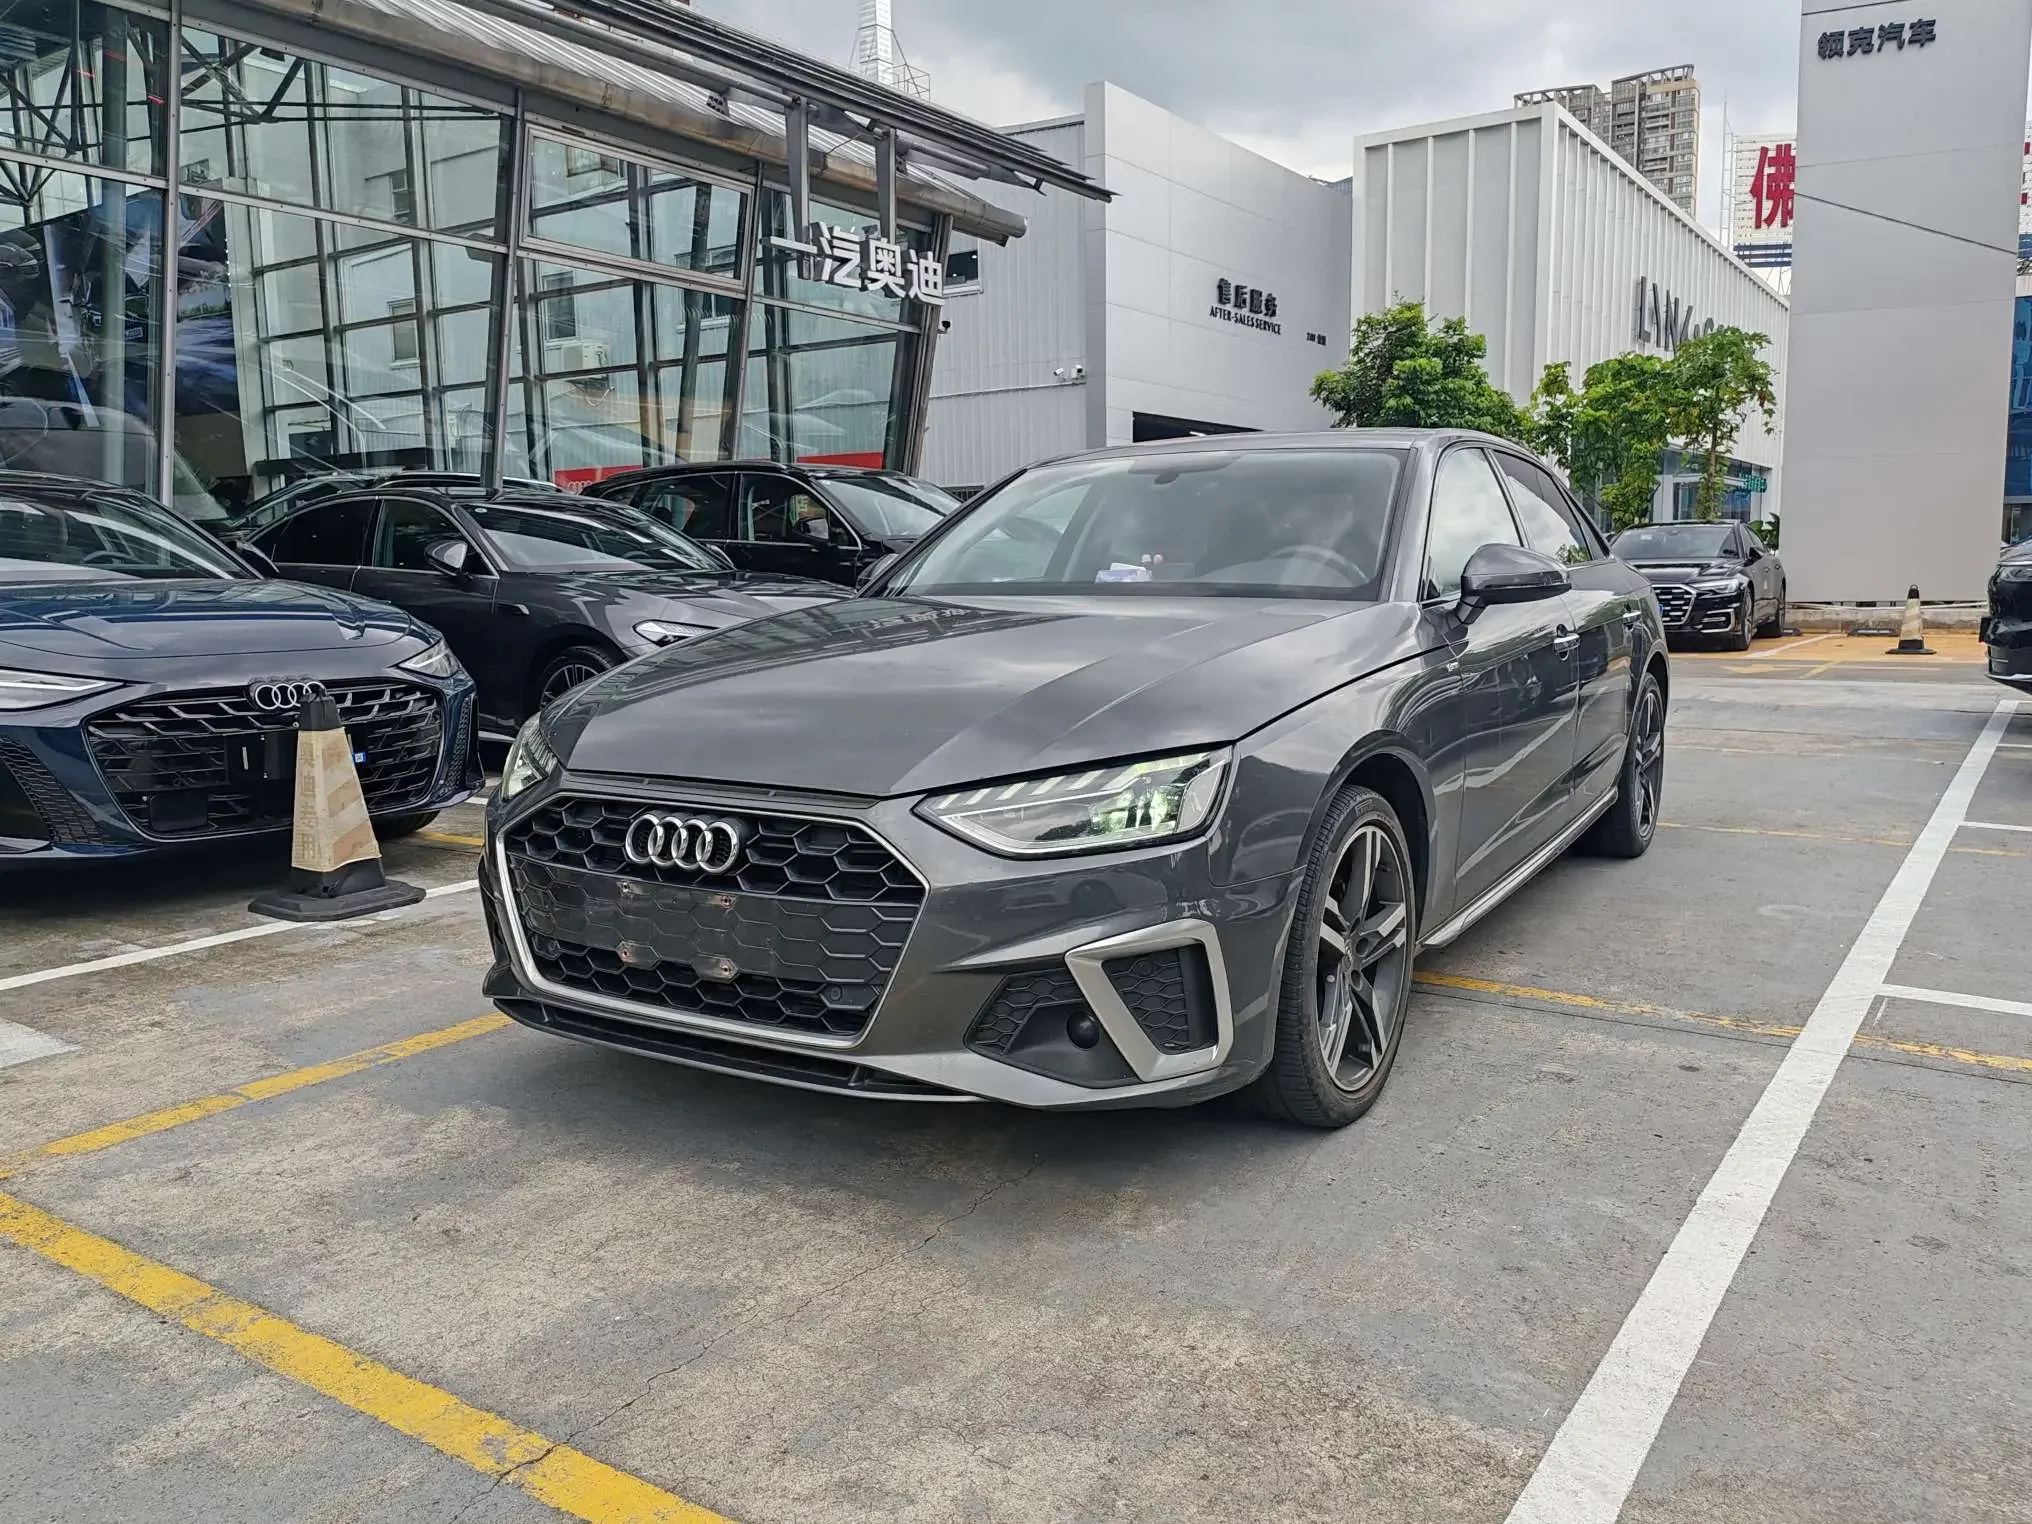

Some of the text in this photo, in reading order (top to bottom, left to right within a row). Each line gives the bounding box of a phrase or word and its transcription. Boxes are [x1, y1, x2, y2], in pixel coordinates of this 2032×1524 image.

[1817, 18, 1937, 60] 领克汽车
[766, 221, 945, 306] 一汽奥迪
[1217, 277, 1278, 318] 售后服务
[1255, 318, 1281, 335] SERVICE
